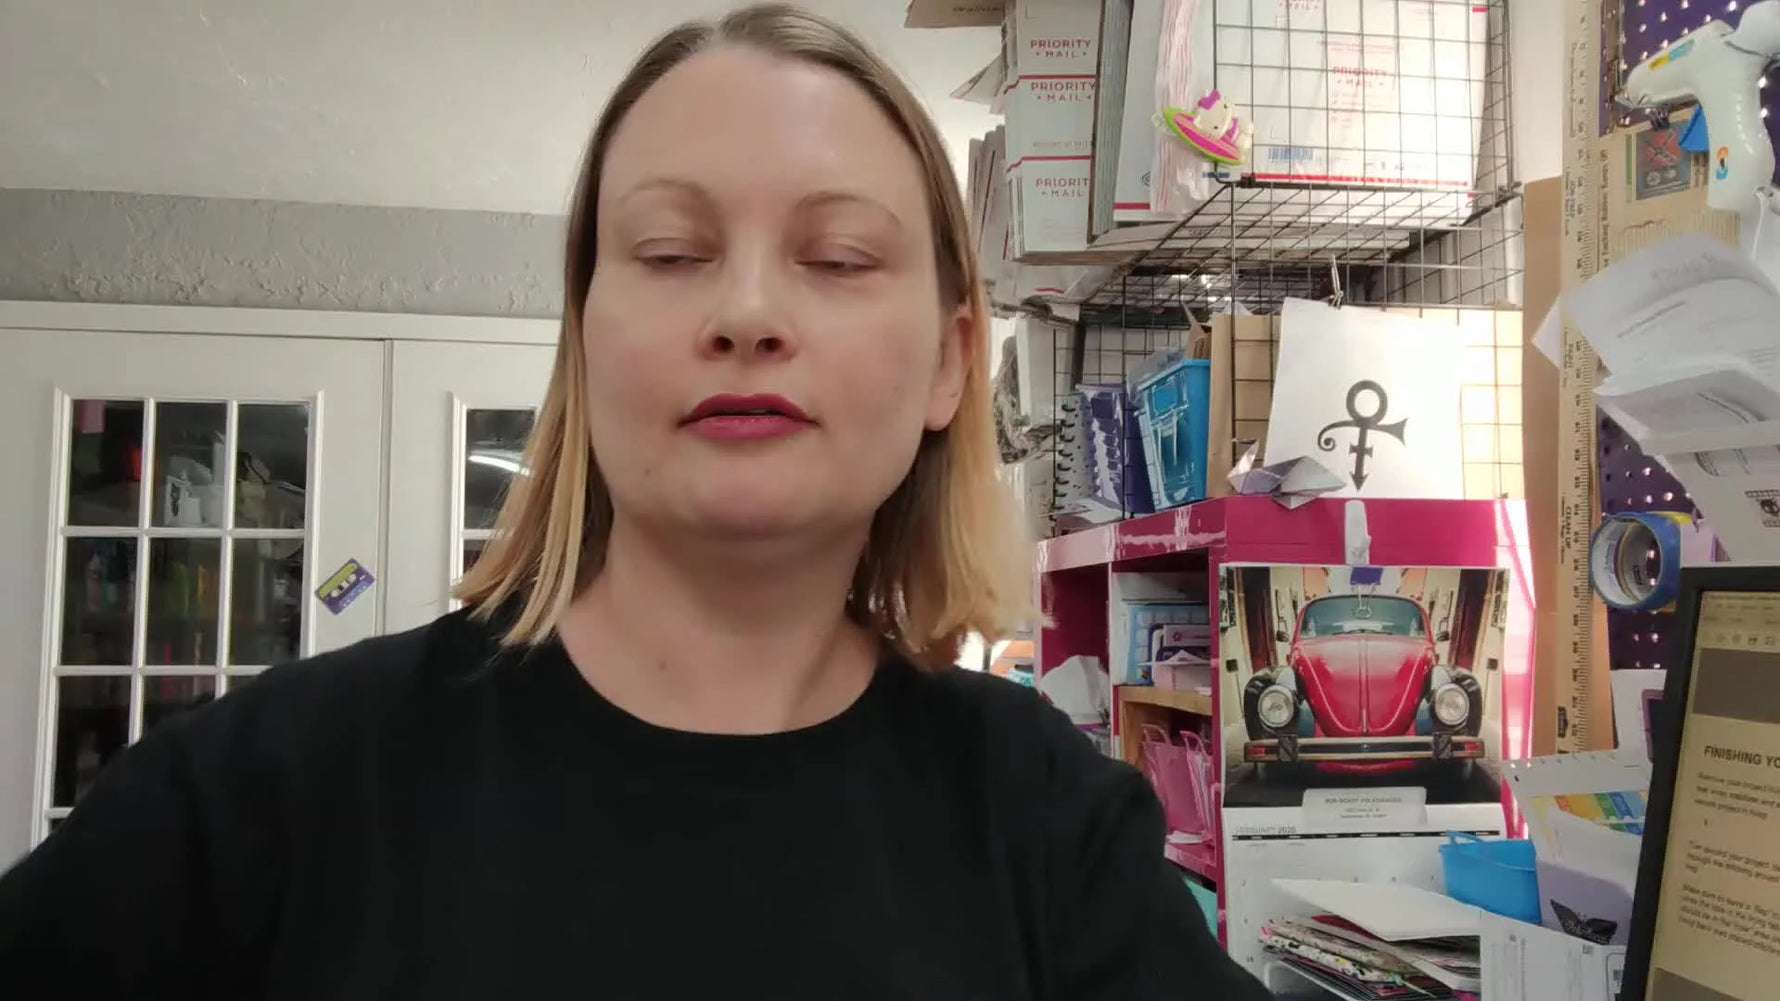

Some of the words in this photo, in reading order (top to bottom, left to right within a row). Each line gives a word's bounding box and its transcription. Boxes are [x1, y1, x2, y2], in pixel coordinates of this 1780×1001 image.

[1030, 39, 1091, 49] PRIORITY
[1031, 81, 1096, 91] PRIORITY
[1565, 537, 1572, 549] UP
[1704, 746, 1761, 765] FINISHING
[1766, 755, 1780, 769] YO
